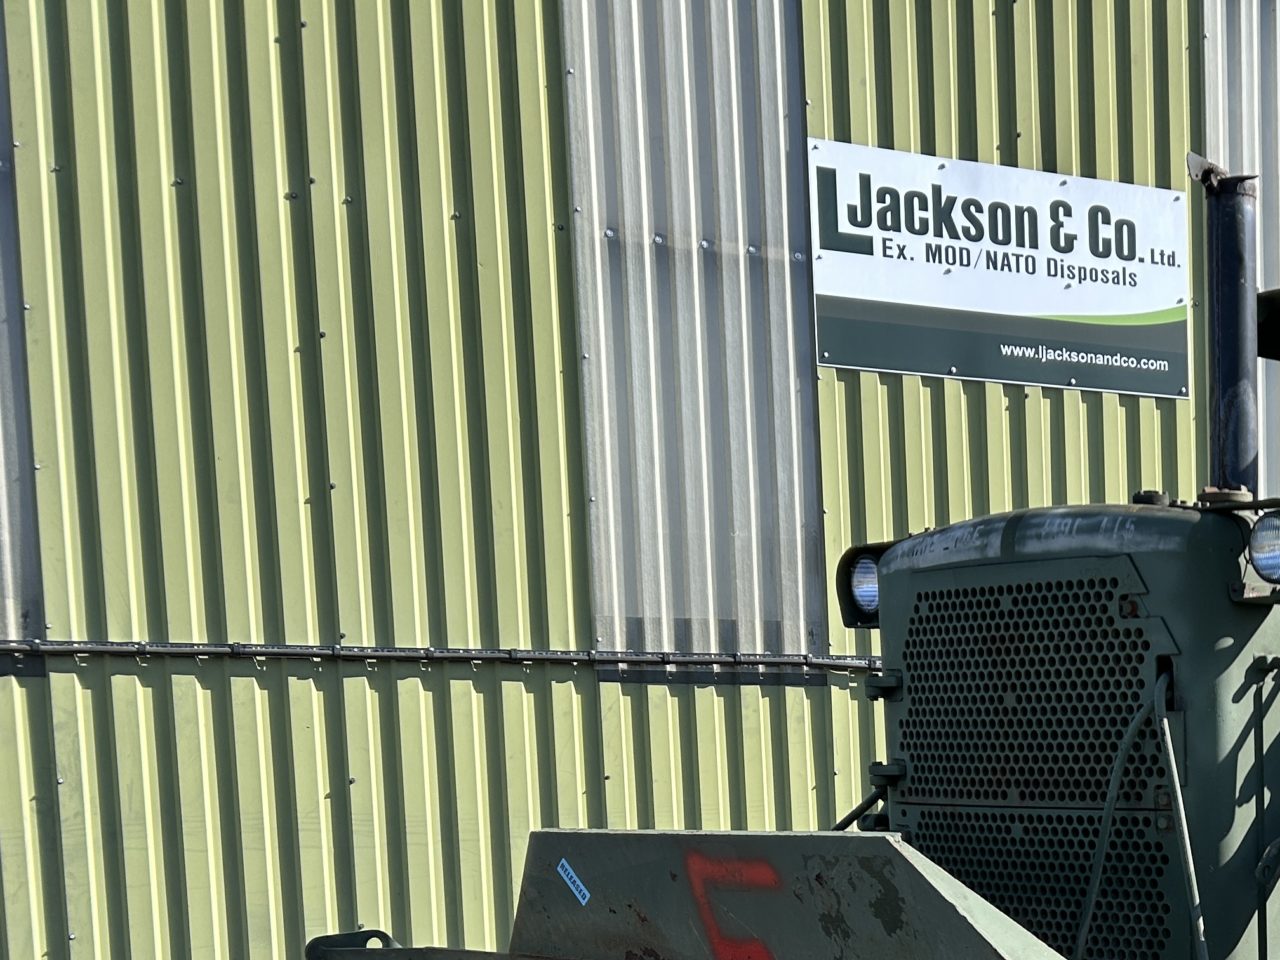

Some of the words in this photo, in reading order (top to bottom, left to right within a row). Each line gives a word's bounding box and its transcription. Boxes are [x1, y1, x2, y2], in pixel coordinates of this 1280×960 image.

[1050, 199, 1078, 254] &
[1087, 204, 1145, 263] Co.
[1150, 248, 1182, 268] Ltd.
[881, 236, 915, 262] Ex.
[925, 242, 1037, 276] MOD/NATO
[1046, 257, 1138, 288] Disposals
[1000, 343, 1169, 372] www.ljacksonandco.com
[559, 862, 588, 902] RELEASED
